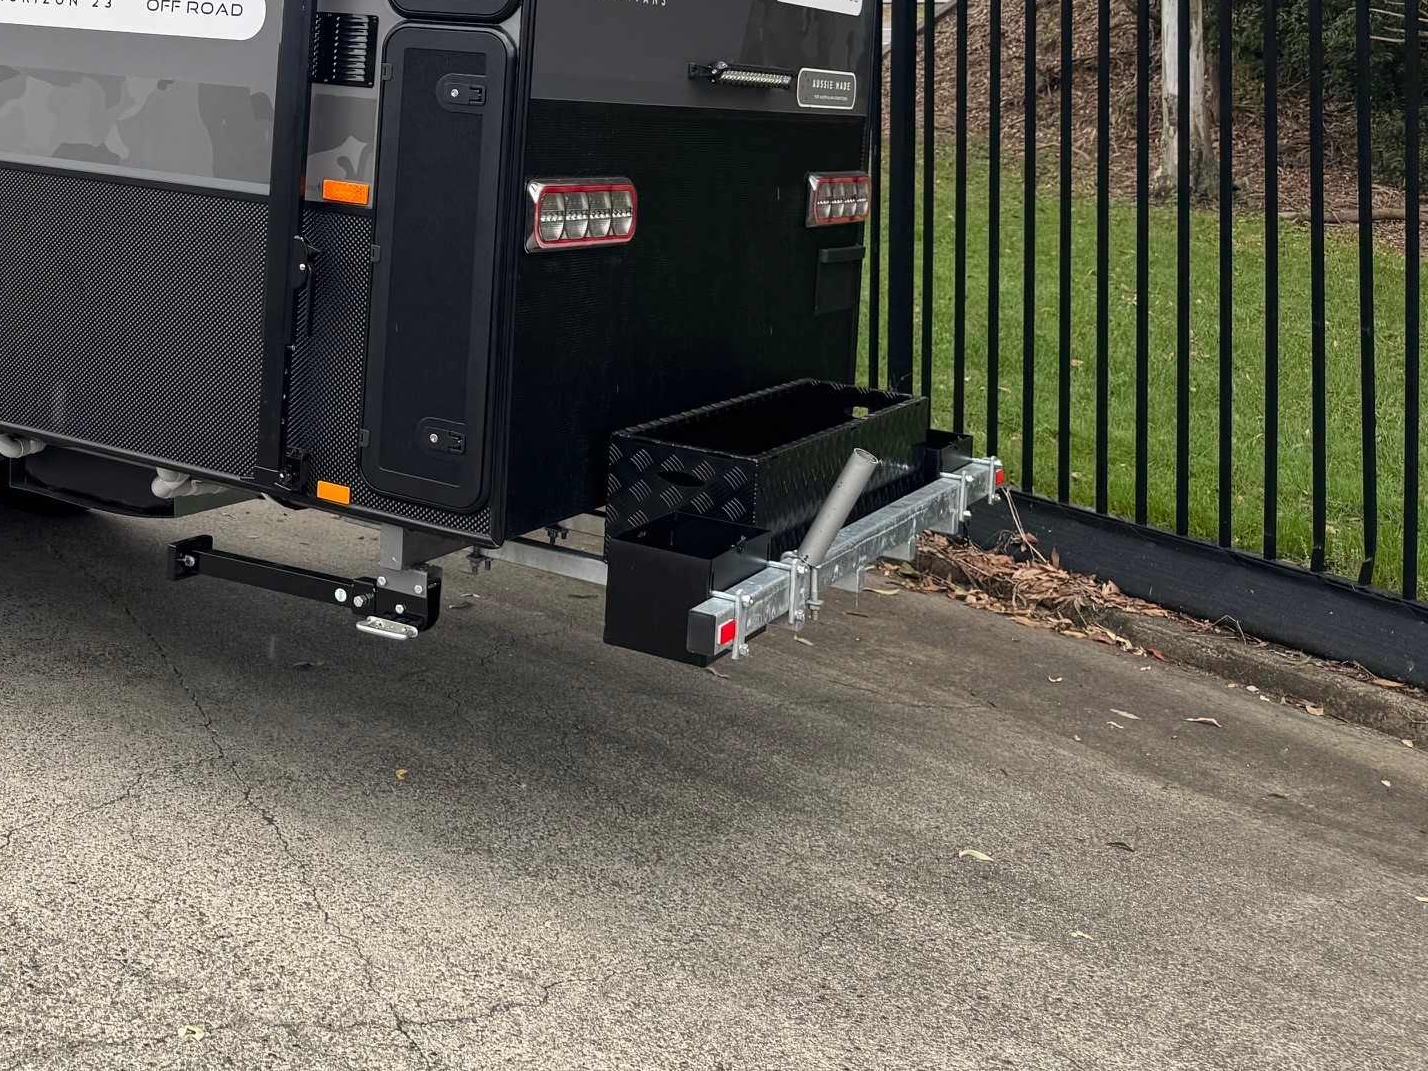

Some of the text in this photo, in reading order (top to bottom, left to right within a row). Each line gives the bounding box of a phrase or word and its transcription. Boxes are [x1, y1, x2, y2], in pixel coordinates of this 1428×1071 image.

[187, 1, 244, 16] ROAD
[812, 79, 851, 91] AUSSIE MADE
